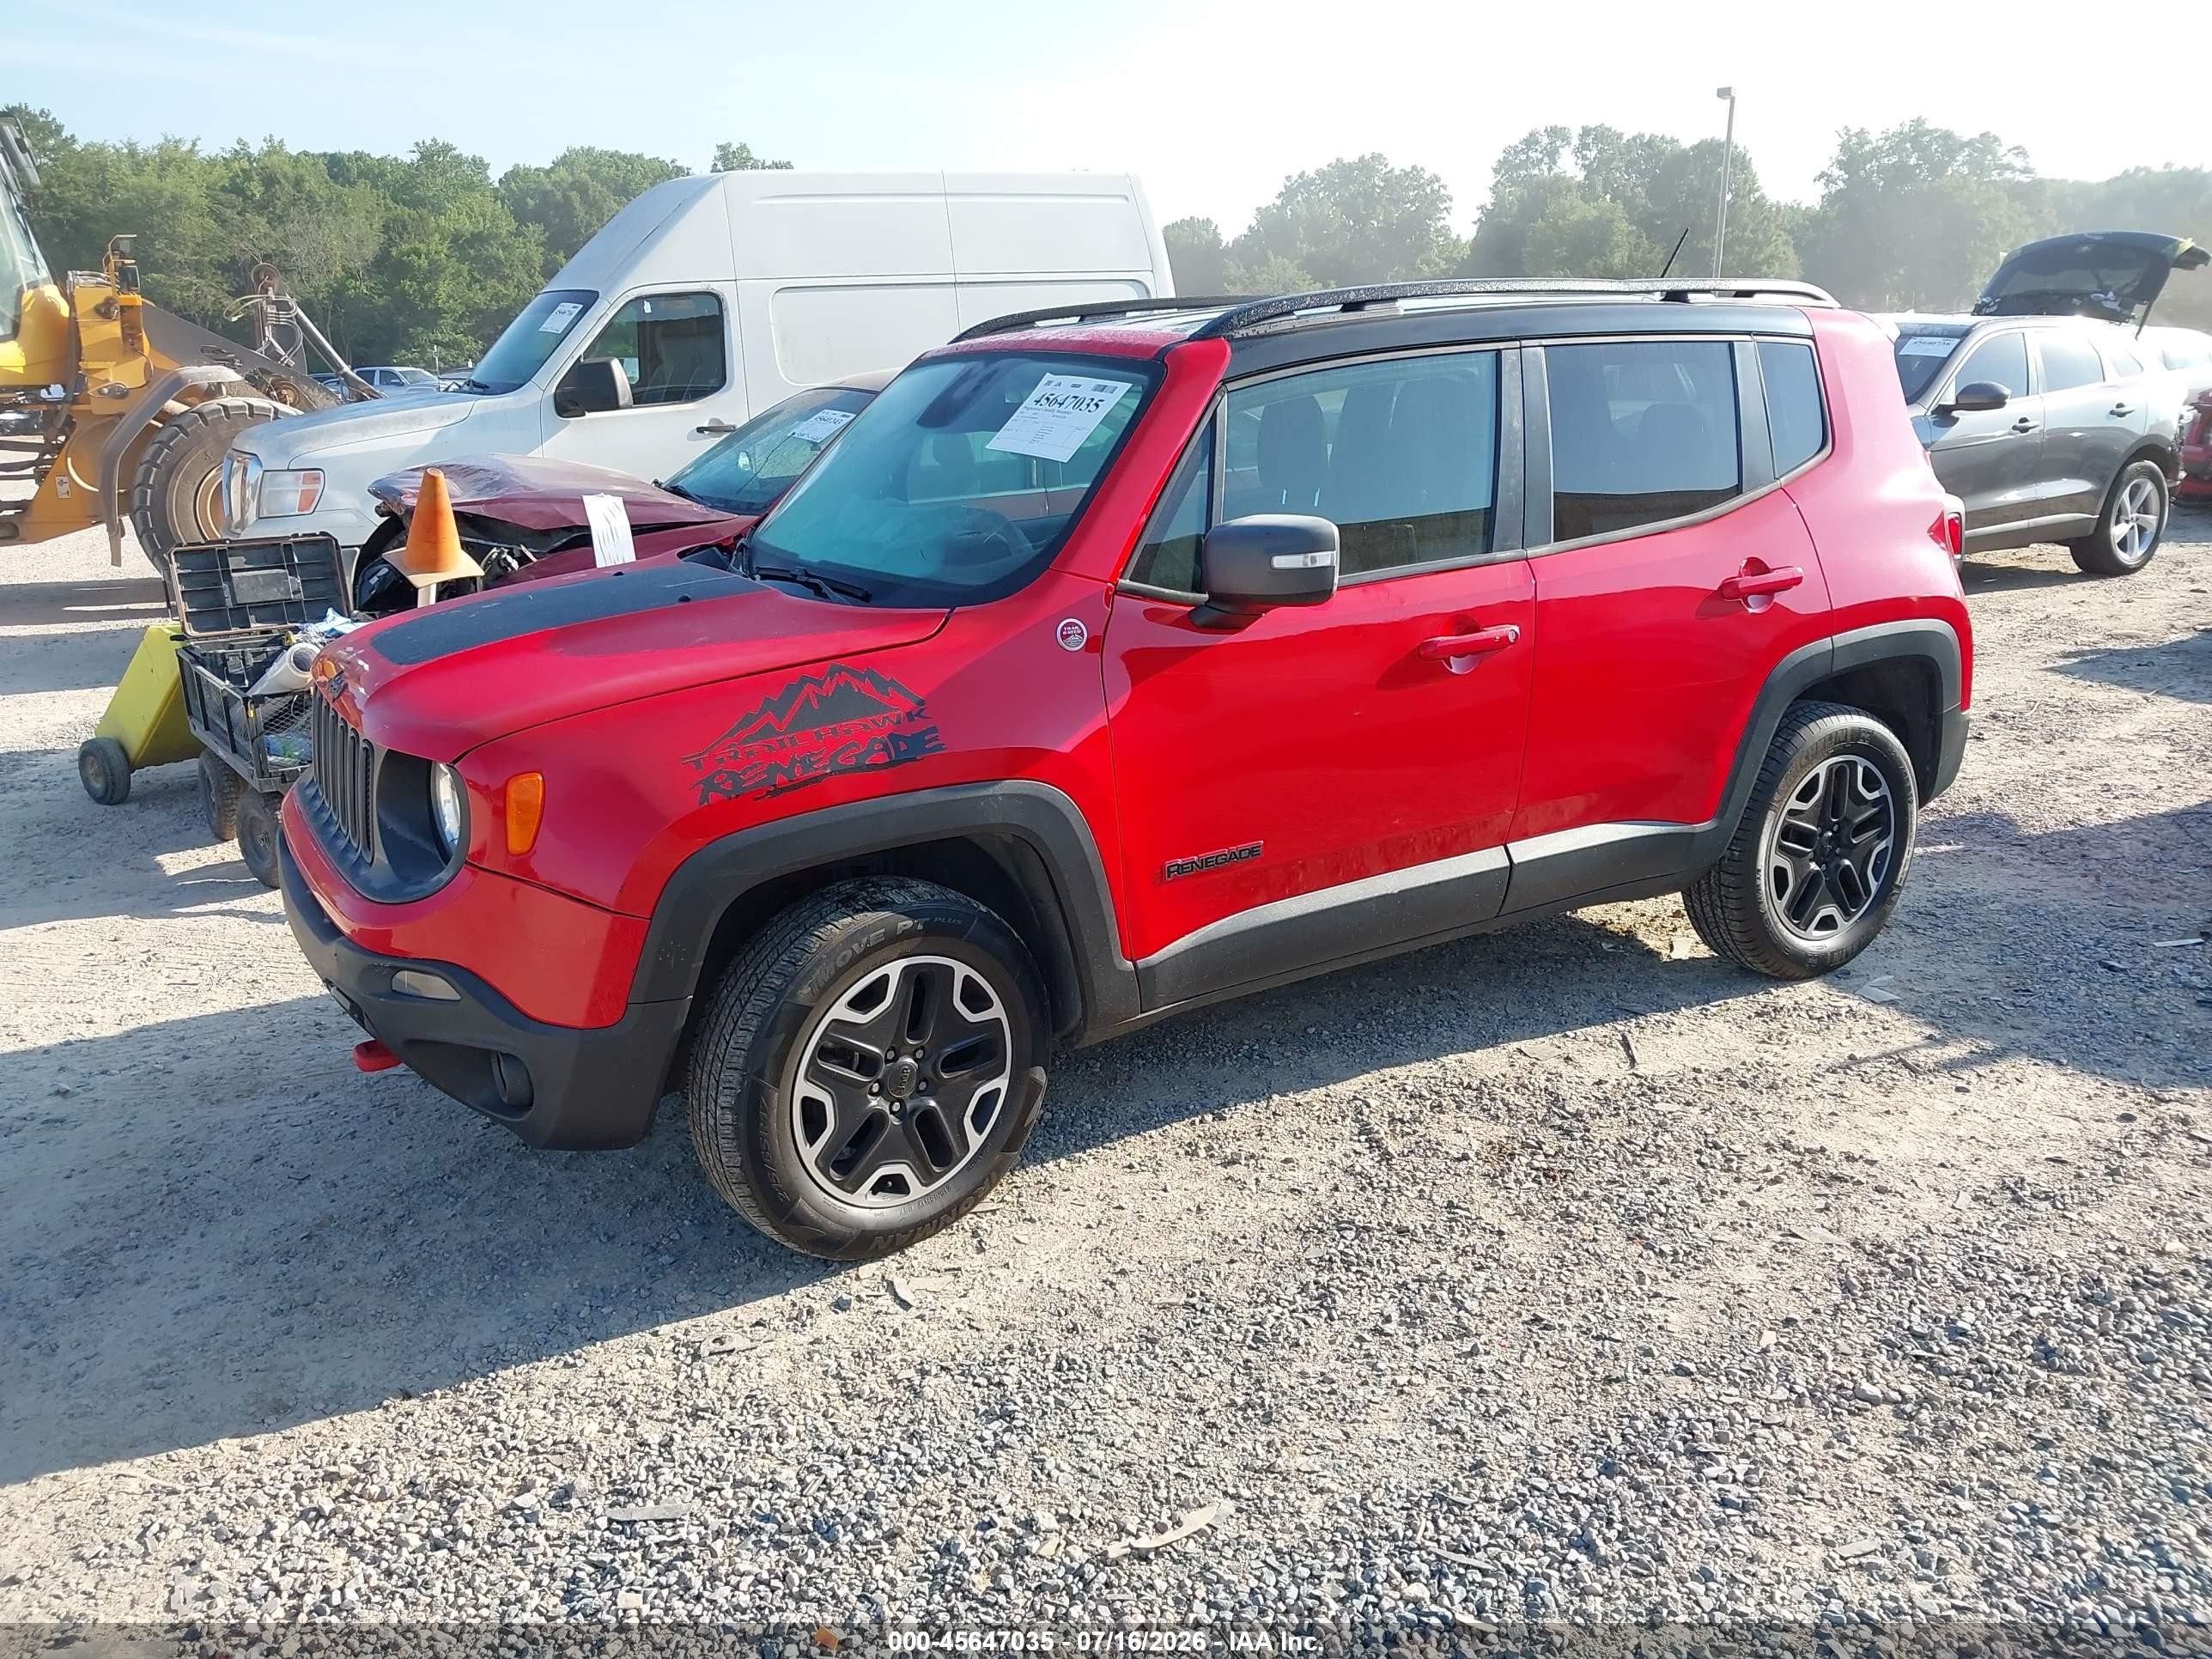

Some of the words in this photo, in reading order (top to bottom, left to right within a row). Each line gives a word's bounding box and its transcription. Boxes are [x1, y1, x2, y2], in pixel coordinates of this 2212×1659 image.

[1034, 392, 1105, 413] 45647035
[688, 726, 947, 808] RENEGADE
[1165, 841, 1263, 880] RENEGADE
[897, 918, 930, 934] PT
